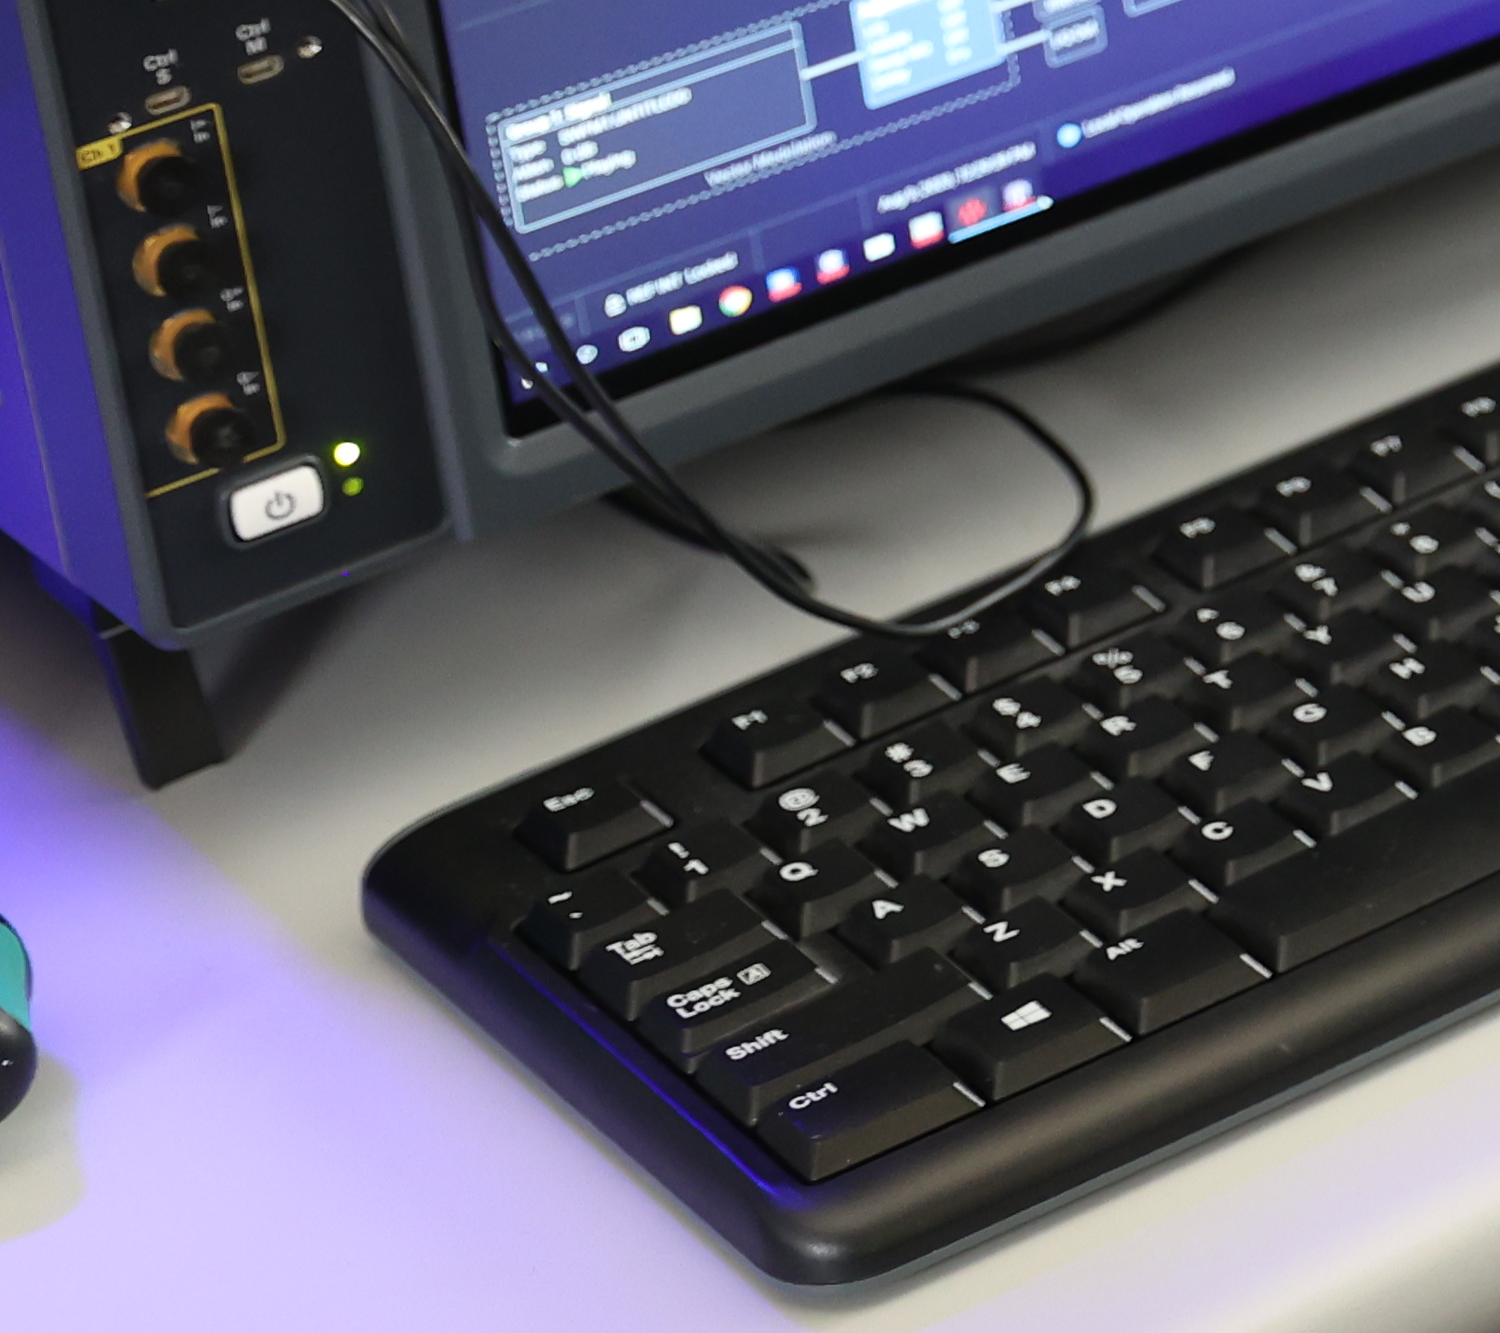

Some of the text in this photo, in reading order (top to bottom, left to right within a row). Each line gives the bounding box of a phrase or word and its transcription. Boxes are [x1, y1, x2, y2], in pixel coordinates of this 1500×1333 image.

[143, 49, 179, 71] Ctrl
[996, 762, 1031, 783] E
[1301, 772, 1333, 792] V
[543, 787, 595, 812] Esc
[1082, 798, 1117, 819] D
[887, 807, 931, 832] W
[1201, 821, 1234, 841] C
[978, 849, 1010, 868] S
[779, 862, 819, 882] Q
[1091, 870, 1127, 892] X
[872, 899, 904, 919] A
[983, 921, 1020, 942] Z
[606, 931, 658, 955] Tab
[1106, 938, 1144, 960] Alt
[667, 975, 733, 1009] Caps
[676, 987, 741, 1019] Lock
[725, 1028, 789, 1061] Shift
[788, 1081, 839, 1110] Ctrl
